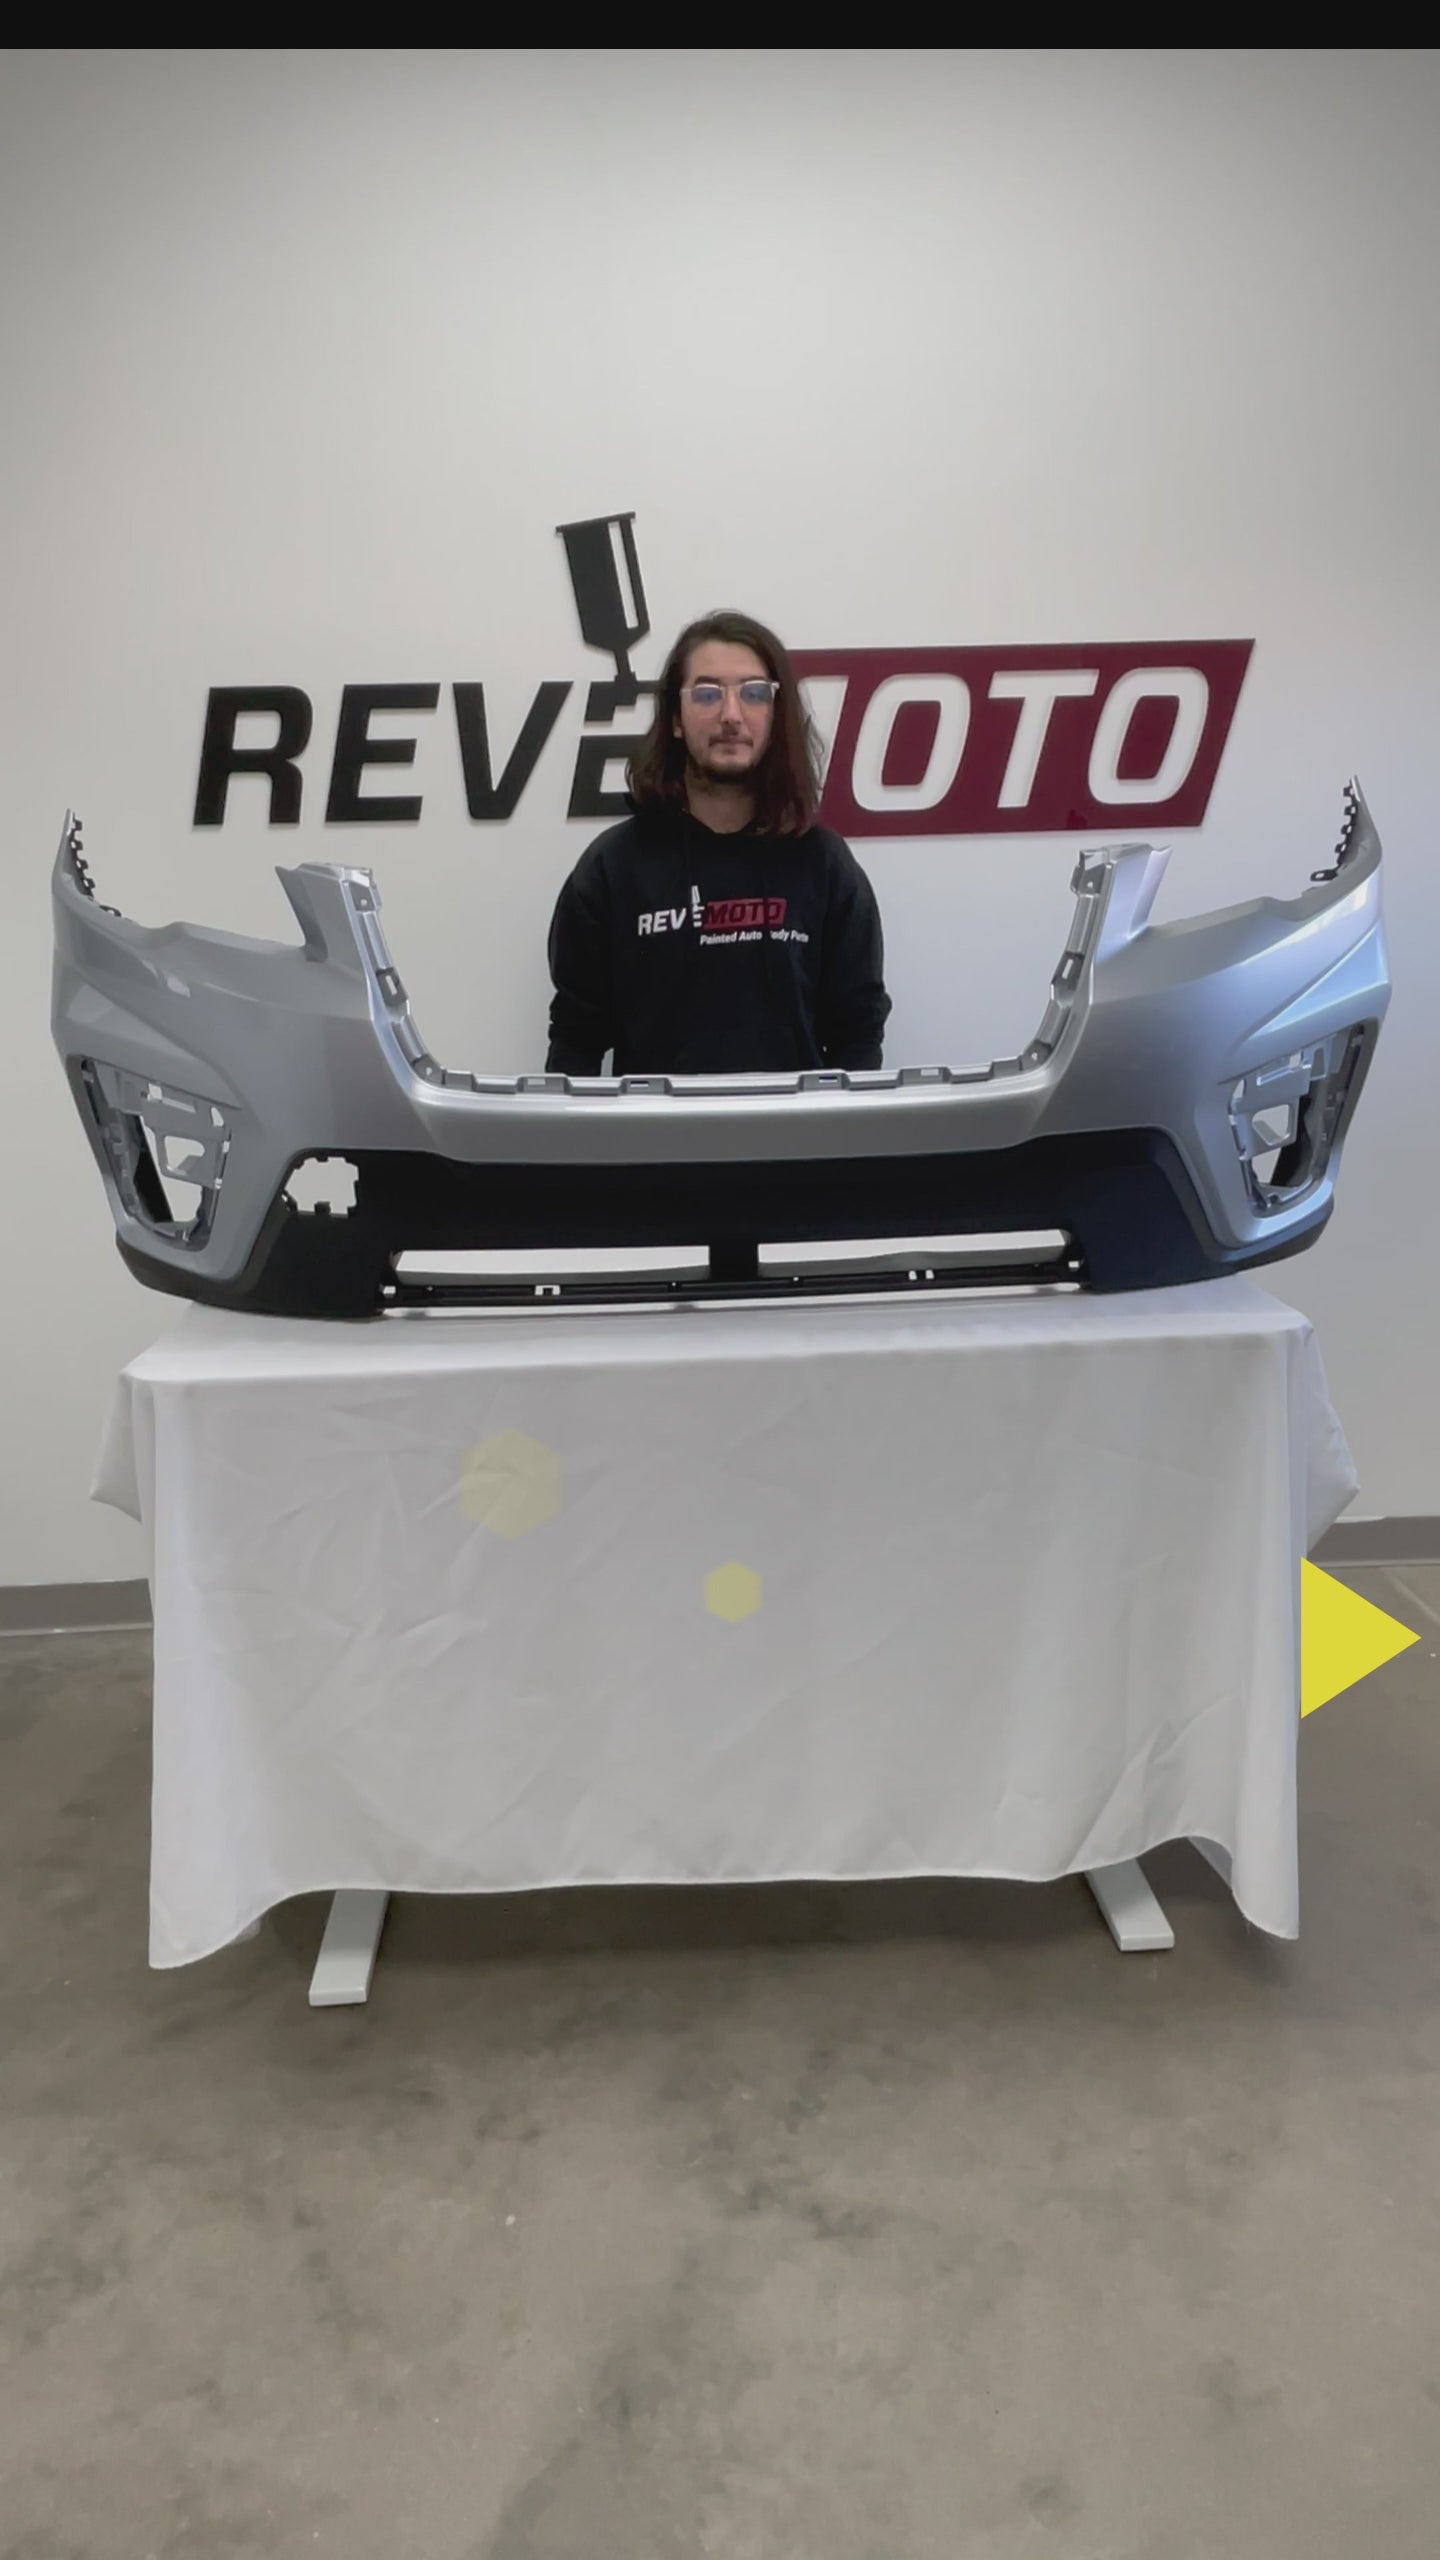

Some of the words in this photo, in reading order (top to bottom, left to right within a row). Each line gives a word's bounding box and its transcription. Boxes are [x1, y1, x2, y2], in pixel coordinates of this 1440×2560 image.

[706, 901, 782, 926] MOTO
[700, 931, 738, 946] Painted
[738, 930, 763, 942] Auto
[770, 928, 790, 943] ody
